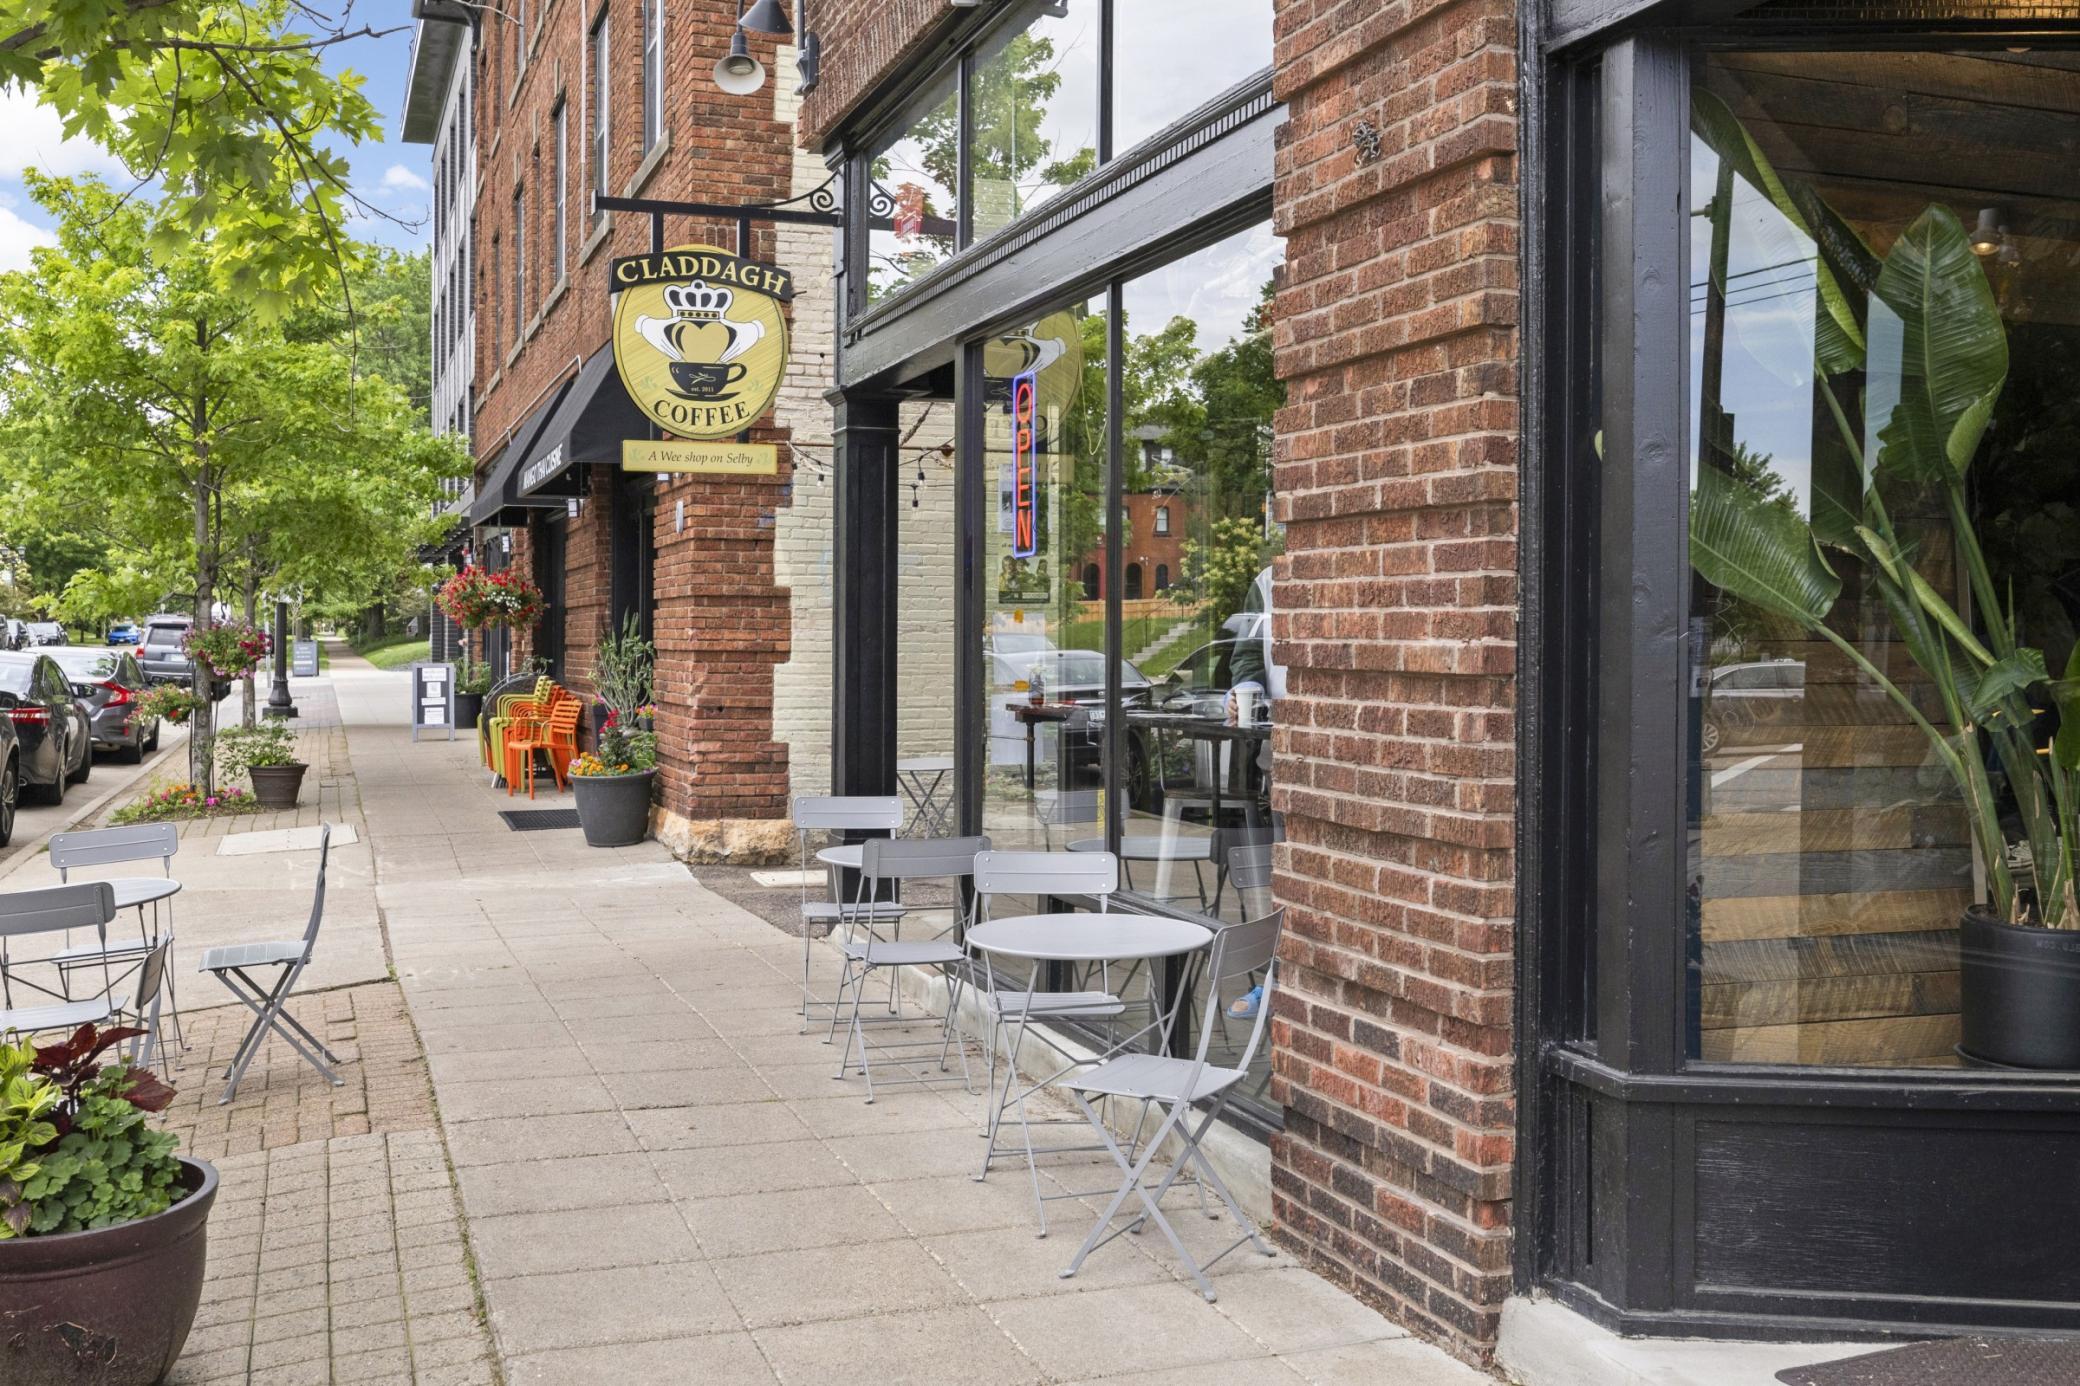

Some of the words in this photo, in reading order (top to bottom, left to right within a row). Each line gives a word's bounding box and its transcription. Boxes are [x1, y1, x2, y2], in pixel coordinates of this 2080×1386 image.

[616, 255, 789, 295] CLADDAGH
[653, 399, 750, 426] COFFEE
[648, 450, 657, 461] A
[661, 450, 682, 462] Wee
[685, 451, 708, 465] shop
[726, 452, 753, 467] Selby
[1016, 383, 1033, 549] OPEN
